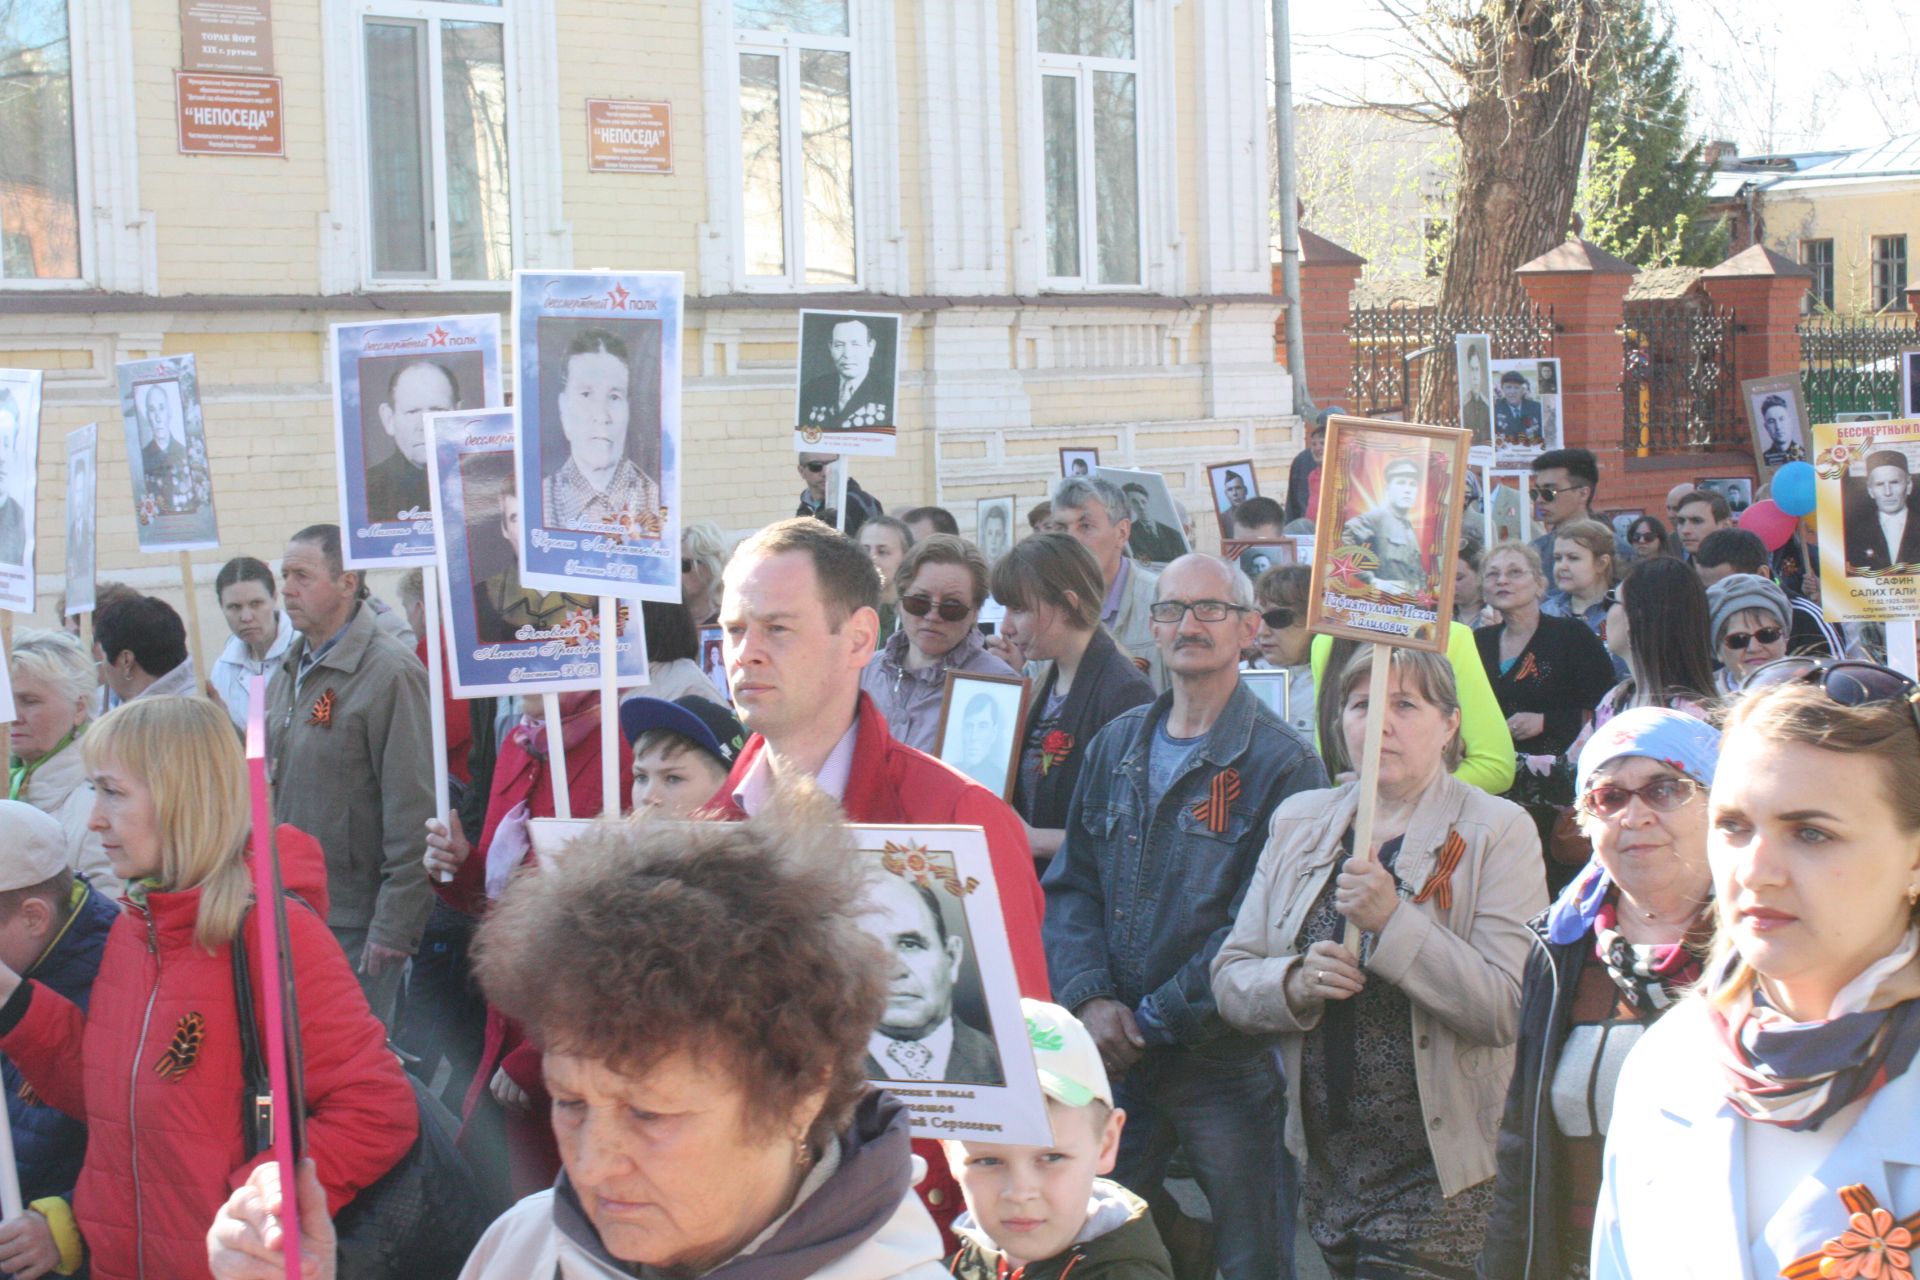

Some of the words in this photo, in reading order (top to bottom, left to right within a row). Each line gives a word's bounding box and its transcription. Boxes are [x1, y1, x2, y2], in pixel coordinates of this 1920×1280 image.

[185, 107, 274, 130] “НЕПОСЕДА”
[1837, 424, 1911, 438] БЕССМЕРТНЫЙ
[1876, 577, 1913, 585] САФИН
[1850, 589, 1886, 598] САЛИХ
[1889, 587, 1917, 596] ГАЛИ
[1325, 592, 1400, 616] Гафиятуллин
[1348, 612, 1410, 634] Халилович
[473, 644, 538, 661] Алексей
[931, 1117, 1003, 1132] Сергеевич
